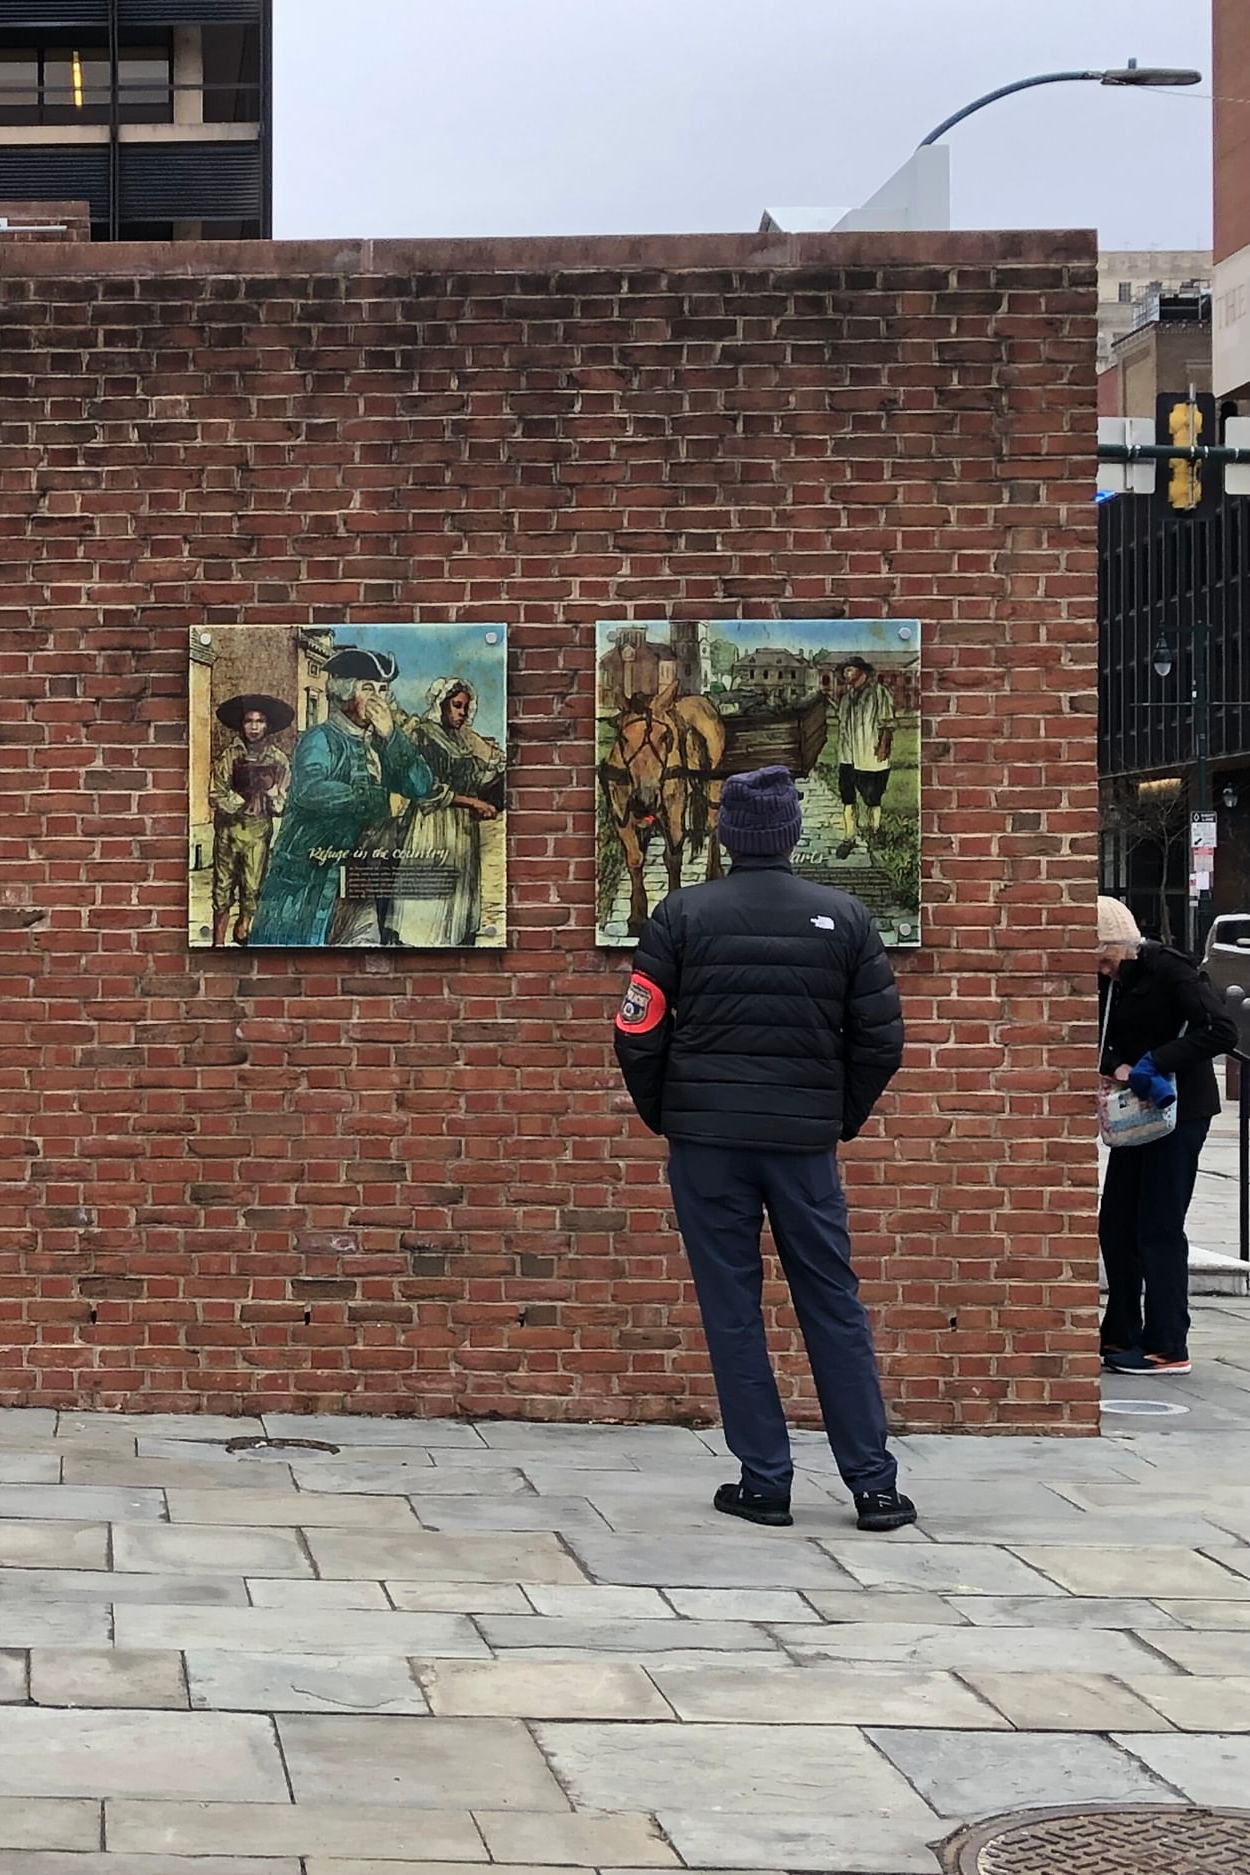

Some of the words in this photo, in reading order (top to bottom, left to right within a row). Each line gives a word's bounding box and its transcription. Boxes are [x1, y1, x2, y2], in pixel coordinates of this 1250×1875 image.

[1215, 283, 1246, 330] THE
[308, 845, 350, 866] Refuge
[353, 846, 368, 860] in
[372, 846, 390, 860] the
[790, 849, 830, 864] arts
